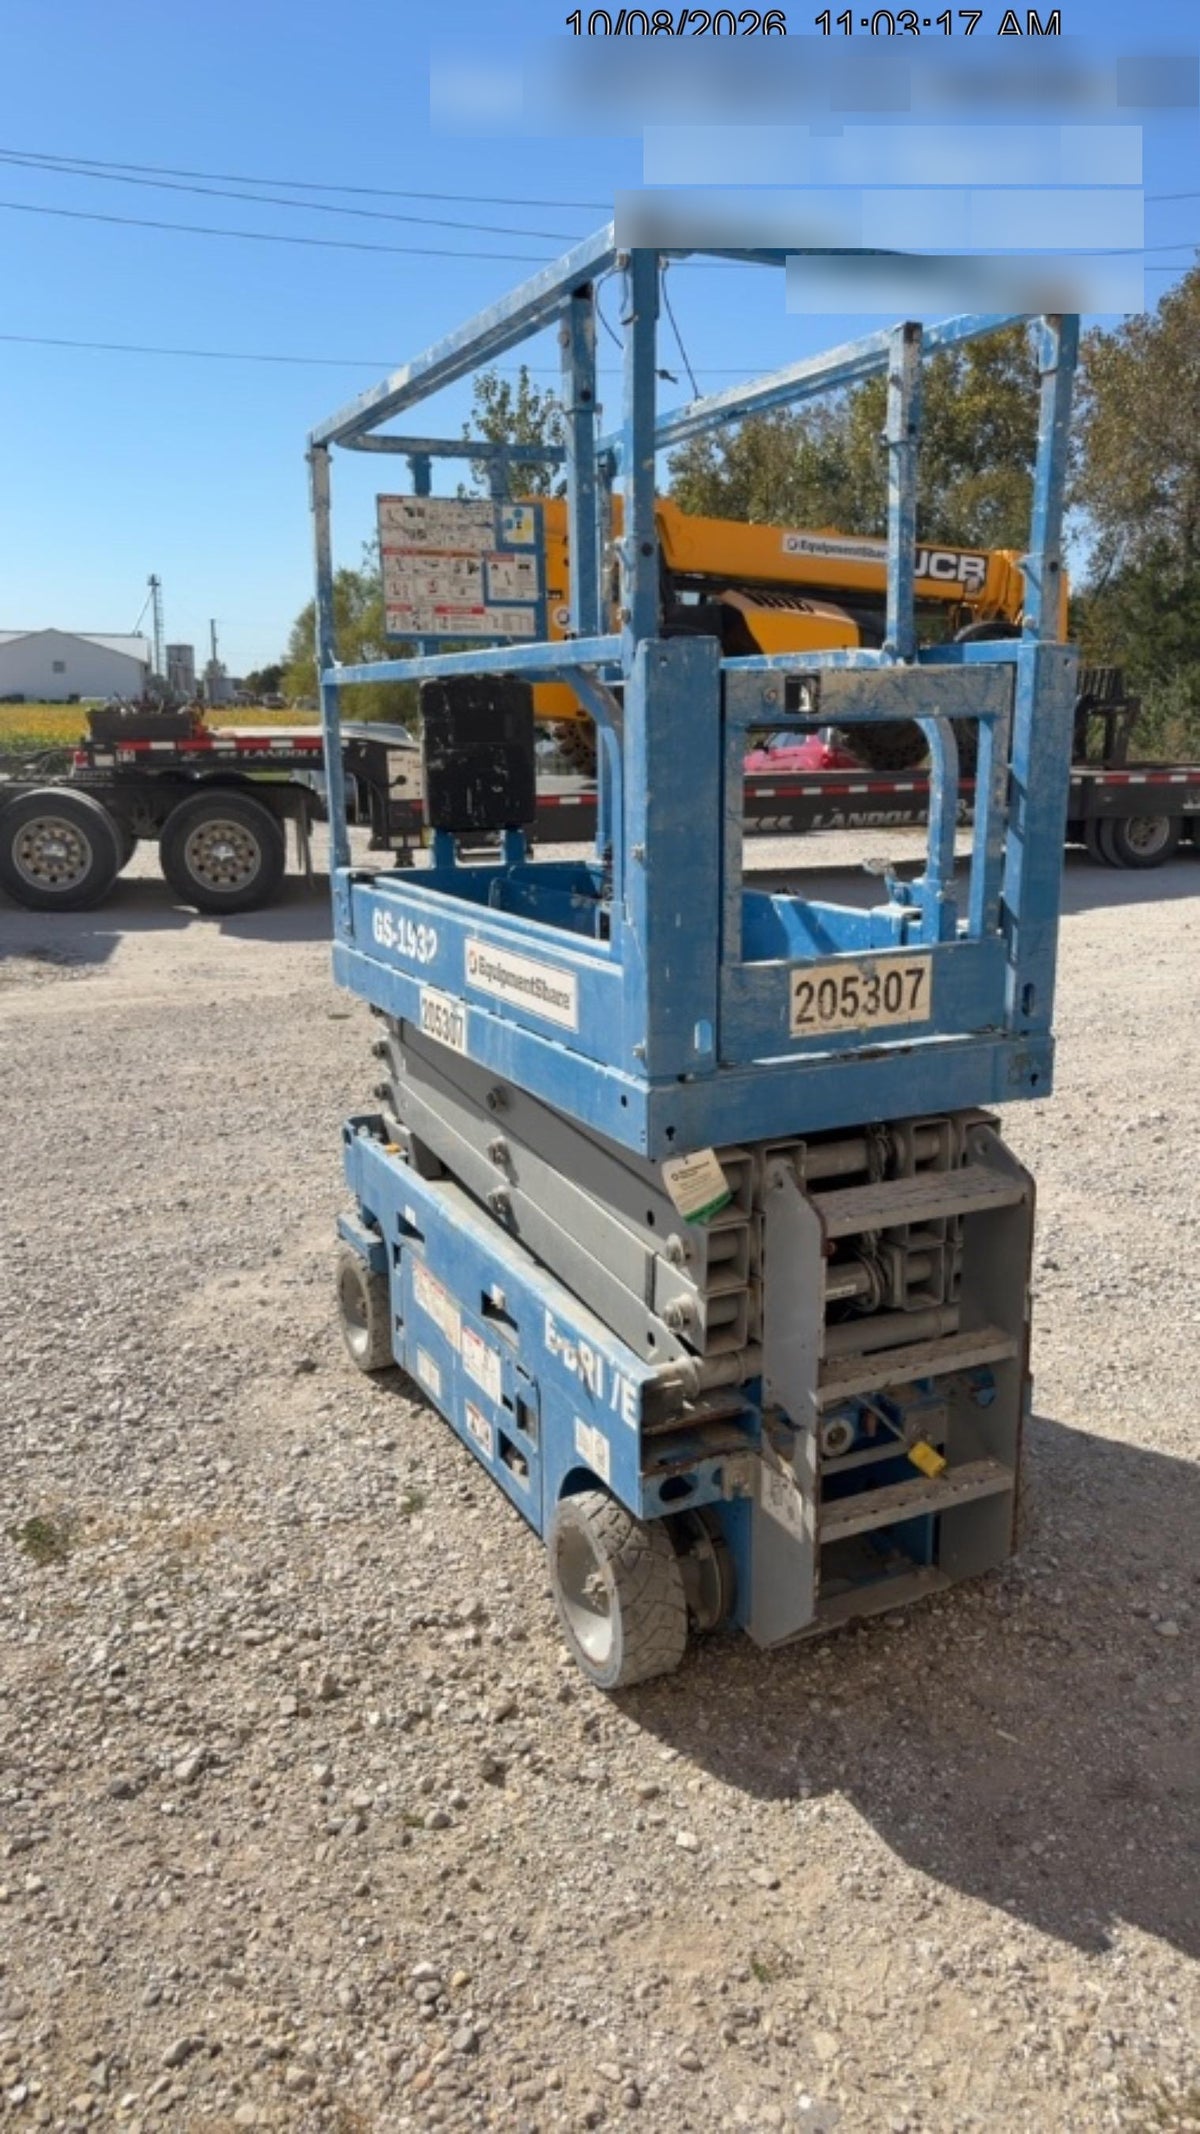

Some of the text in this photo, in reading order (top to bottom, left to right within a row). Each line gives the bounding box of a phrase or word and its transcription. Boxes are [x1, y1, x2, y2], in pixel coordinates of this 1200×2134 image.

[914, 550, 986, 582] JCB
[373, 907, 438, 963] GS-1932
[479, 955, 571, 1011] EquipmentShare
[794, 967, 924, 1025] 205307
[422, 998, 463, 1048] 205307
